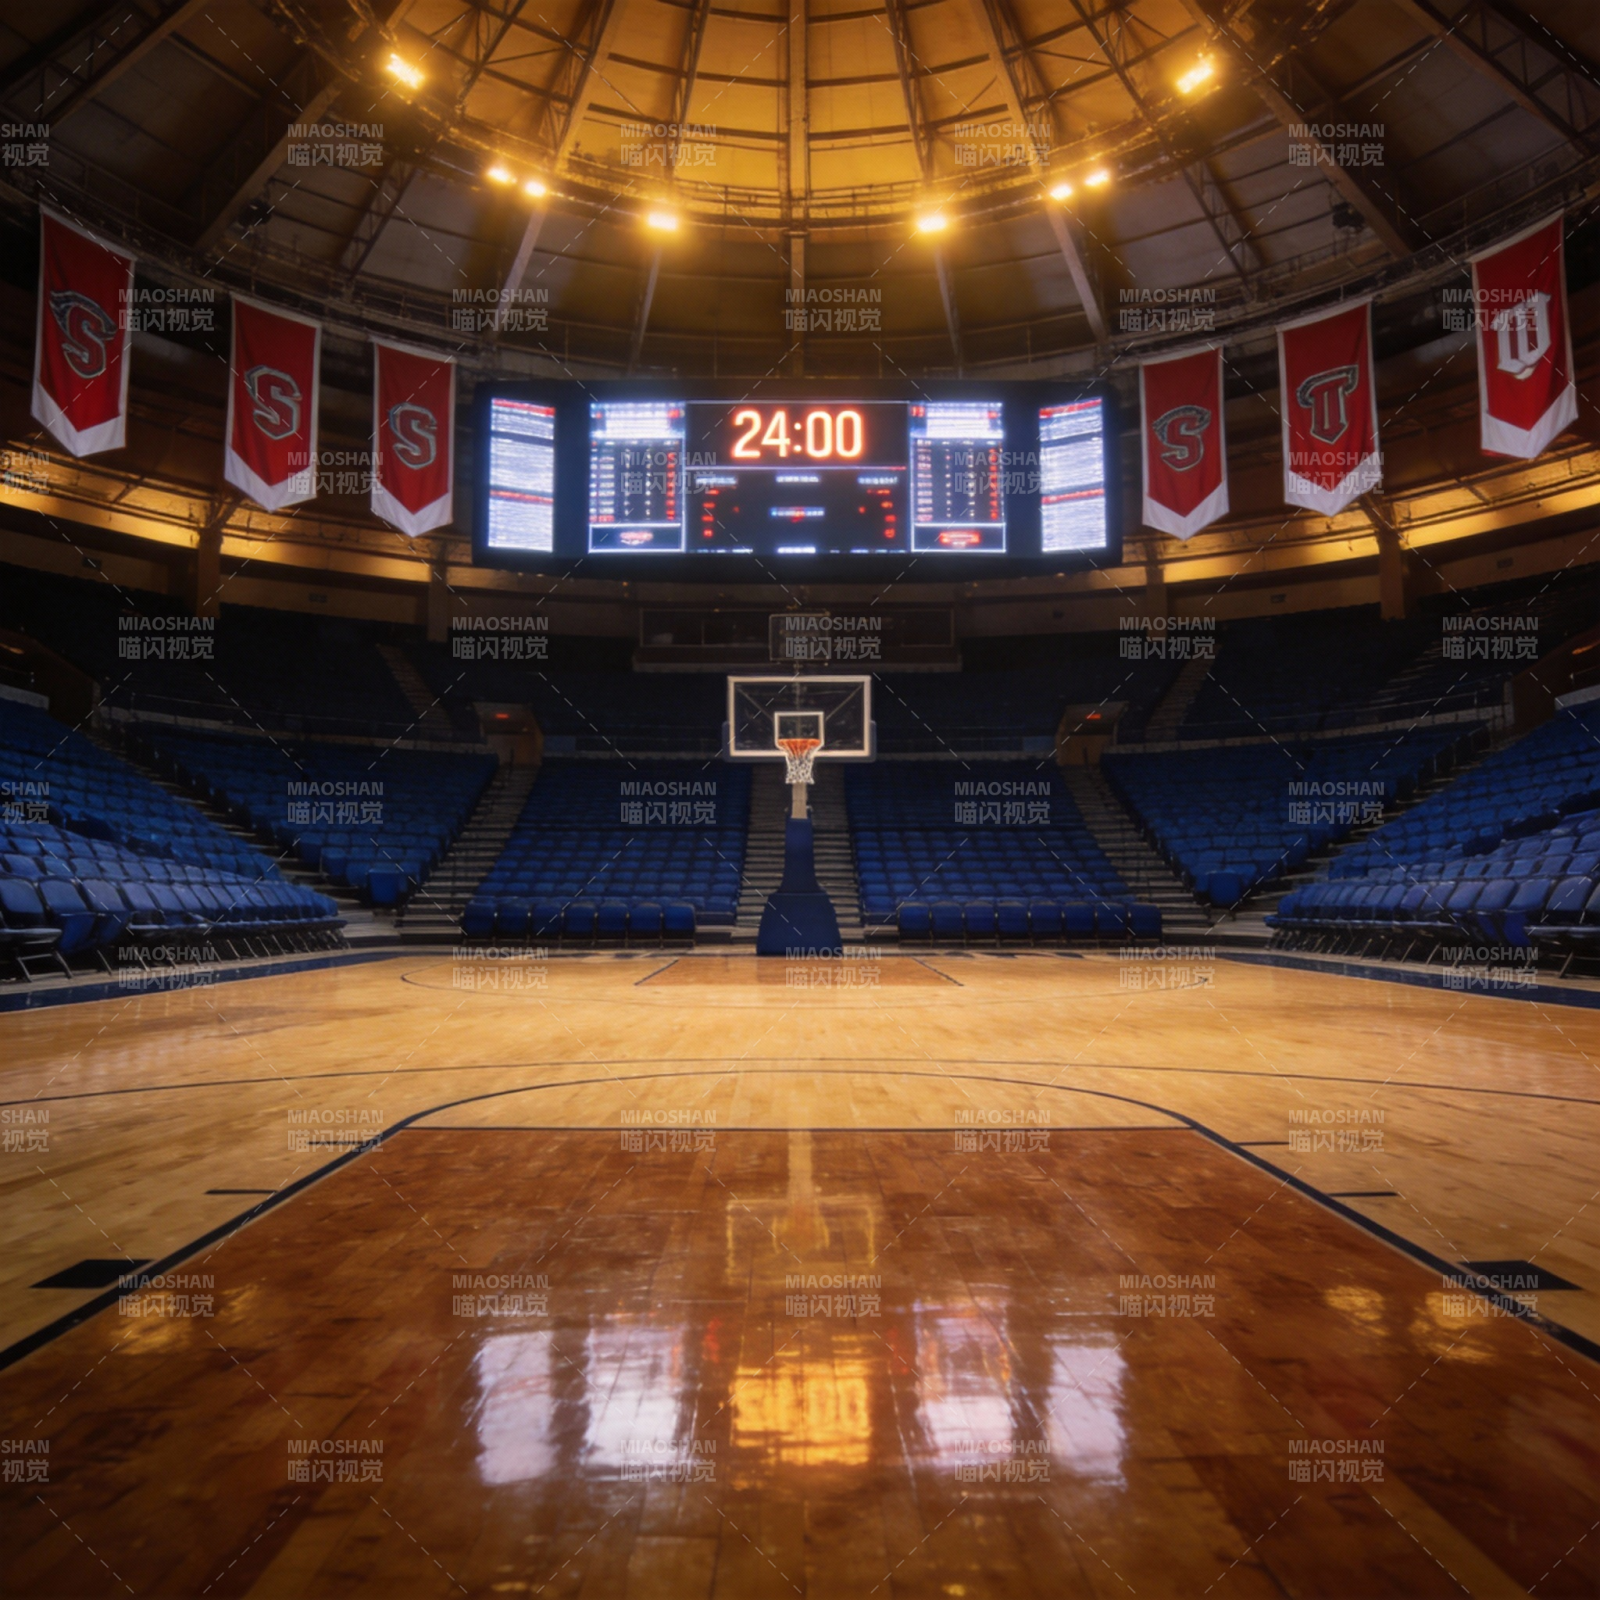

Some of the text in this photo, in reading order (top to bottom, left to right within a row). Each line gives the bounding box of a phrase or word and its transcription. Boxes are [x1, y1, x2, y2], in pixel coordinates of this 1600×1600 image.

[245, 365, 302, 440] S
[389, 402, 438, 470] S
[733, 409, 863, 458] 24:00
